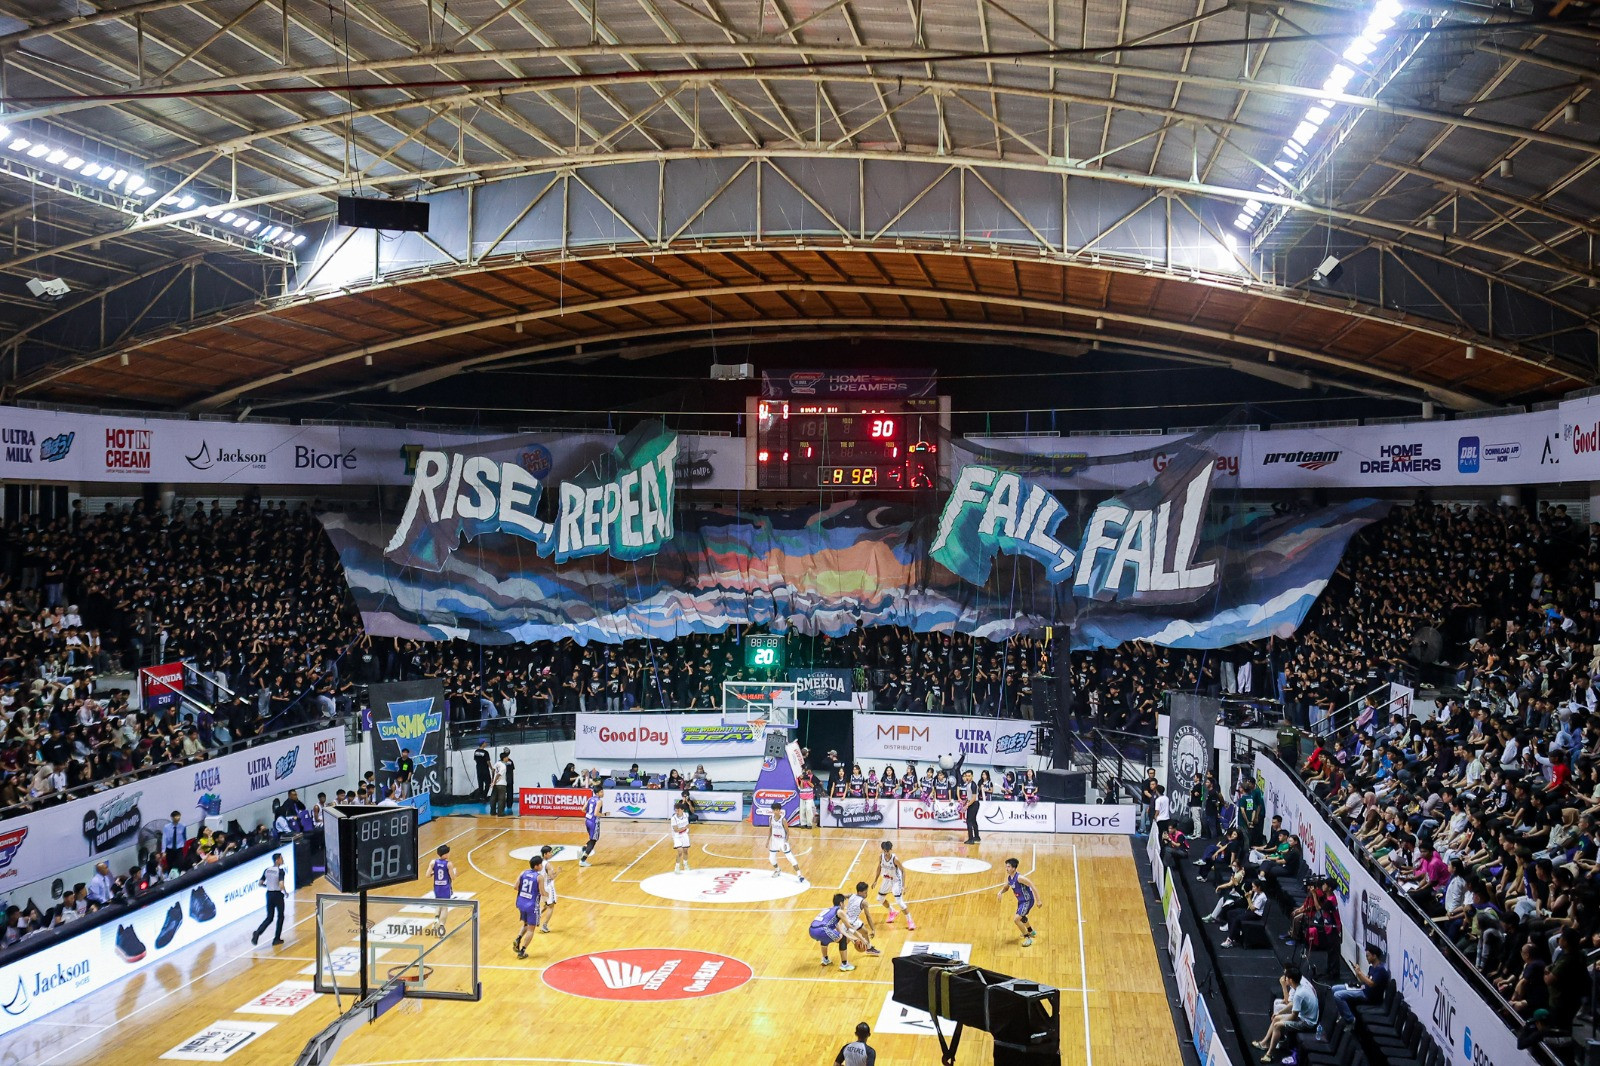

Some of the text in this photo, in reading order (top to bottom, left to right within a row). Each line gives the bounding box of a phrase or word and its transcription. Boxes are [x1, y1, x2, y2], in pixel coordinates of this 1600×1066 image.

[829, 375, 870, 383] HOME
[829, 383, 908, 392] DREAMERS
[872, 420, 894, 437] 30
[2, 428, 36, 446] ULTRA
[106, 428, 150, 449] HOT IN
[5, 447, 33, 463] MILK
[216, 448, 266, 463] Jackson
[294, 446, 357, 469] Bioré
[1263, 450, 1340, 465] proteam
[1380, 444, 1422, 457] HOME
[1460, 446, 1478, 459] DBL
[1485, 447, 1510, 456] DOWNLOAD
[105, 450, 150, 468] CREAM
[1360, 459, 1441, 473] DREAMERS
[559, 436, 678, 553] REPEAT
[1074, 460, 1216, 592] FALL
[754, 649, 774, 665] 20
[796, 676, 845, 694] SMEKDA
[396, 713, 426, 739] SMK
[877, 724, 930, 742] MPM
[599, 727, 669, 746] Good Day
[955, 729, 992, 742] ULTRA
[313, 740, 327, 756] HOT
[958, 742, 988, 754] MILK
[247, 756, 272, 776] ULTRA
[314, 752, 337, 768] CREAM
[193, 766, 221, 792] AQUA
[250, 772, 270, 792] MILK
[524, 794, 587, 805] HOT IN CREAM
[614, 792, 647, 805] AQUA
[1008, 811, 1048, 820] Jackson
[1071, 812, 1120, 828] Bioré
[437, 869, 444, 881] 8
[522, 879, 534, 893] 21
[33, 959, 91, 997] Jackson
[642, 959, 682, 991] HONDA
[1401, 947, 1424, 998] posh
[1432, 984, 1456, 1047] ZINC
